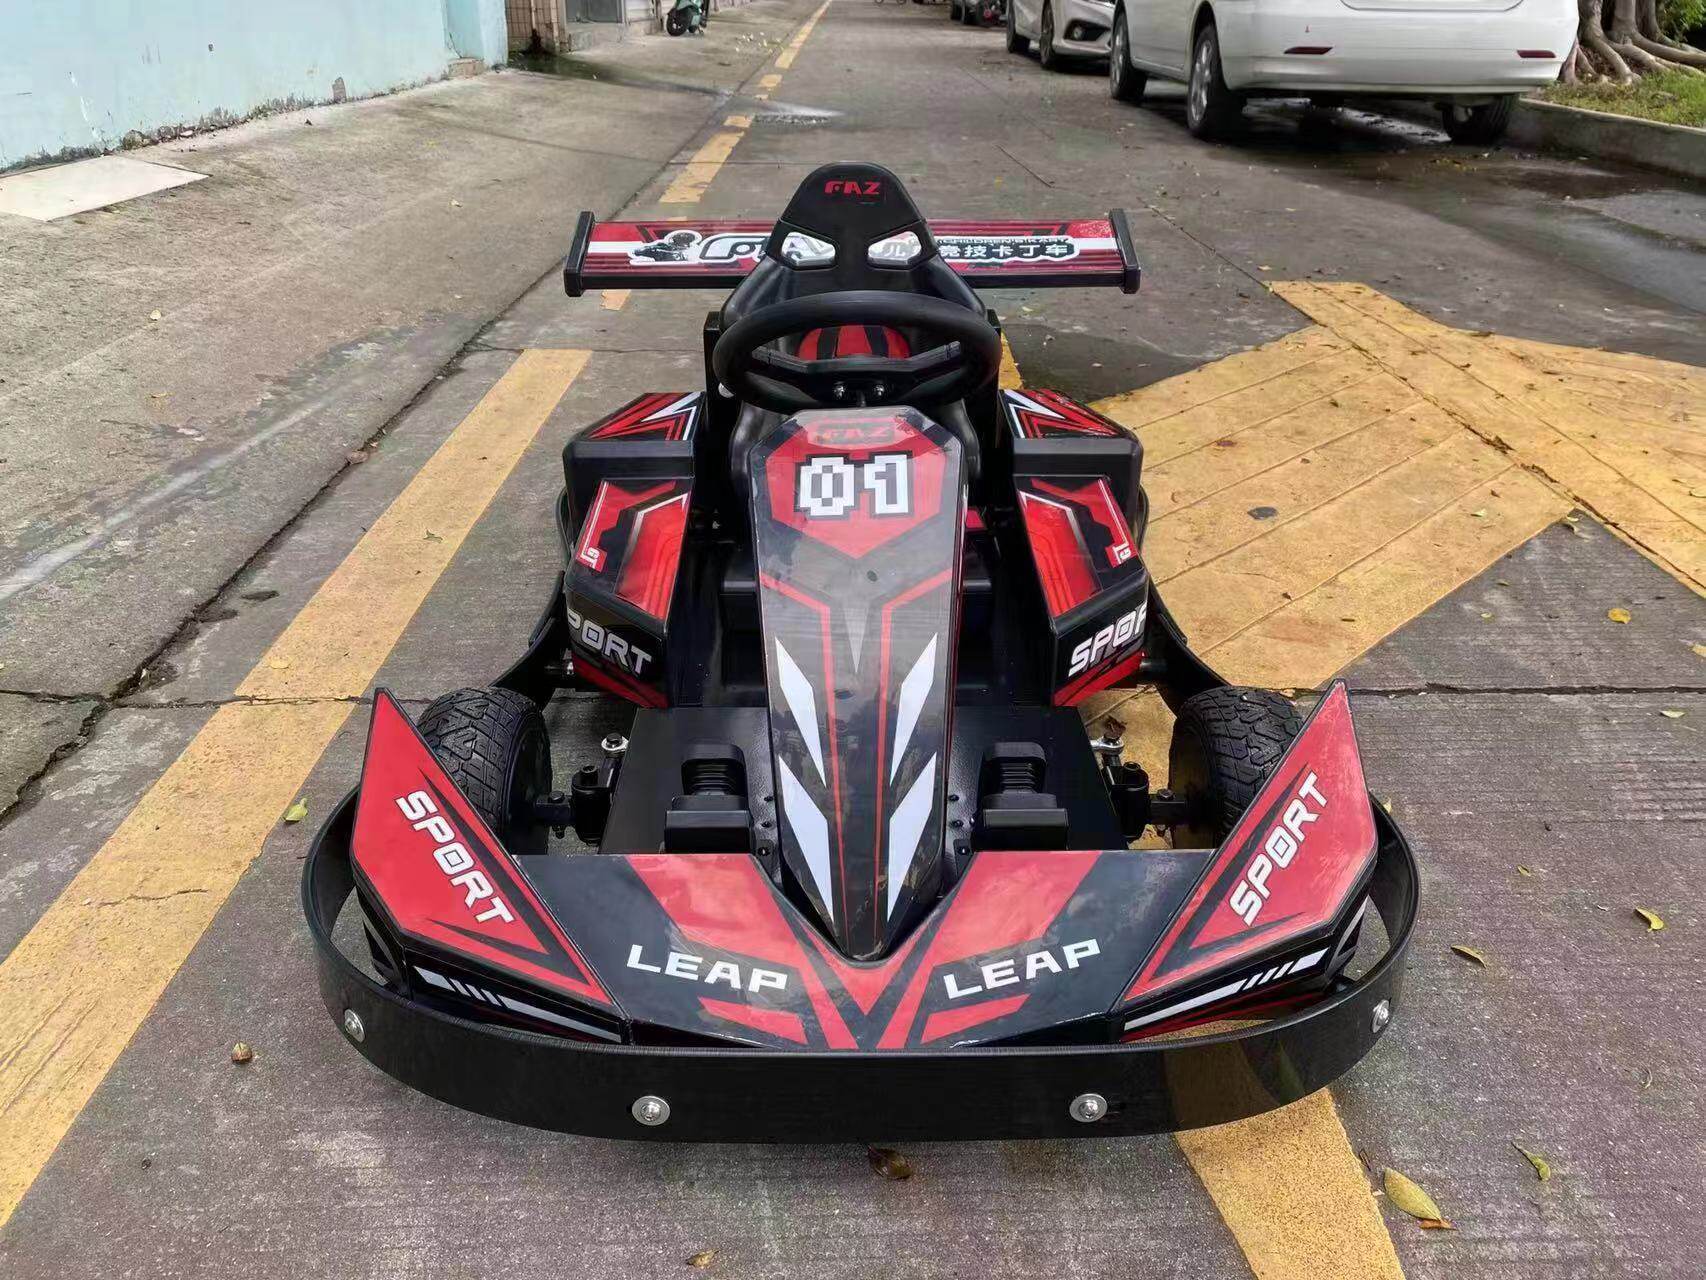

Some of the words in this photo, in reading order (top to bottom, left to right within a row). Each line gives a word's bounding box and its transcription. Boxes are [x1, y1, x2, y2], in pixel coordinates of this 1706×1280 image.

[799, 454, 909, 517] 01
[395, 790, 516, 924] SPORT
[1229, 771, 1328, 926] SPORT
[626, 944, 788, 994] LEAP
[943, 938, 1101, 999] LEAP
